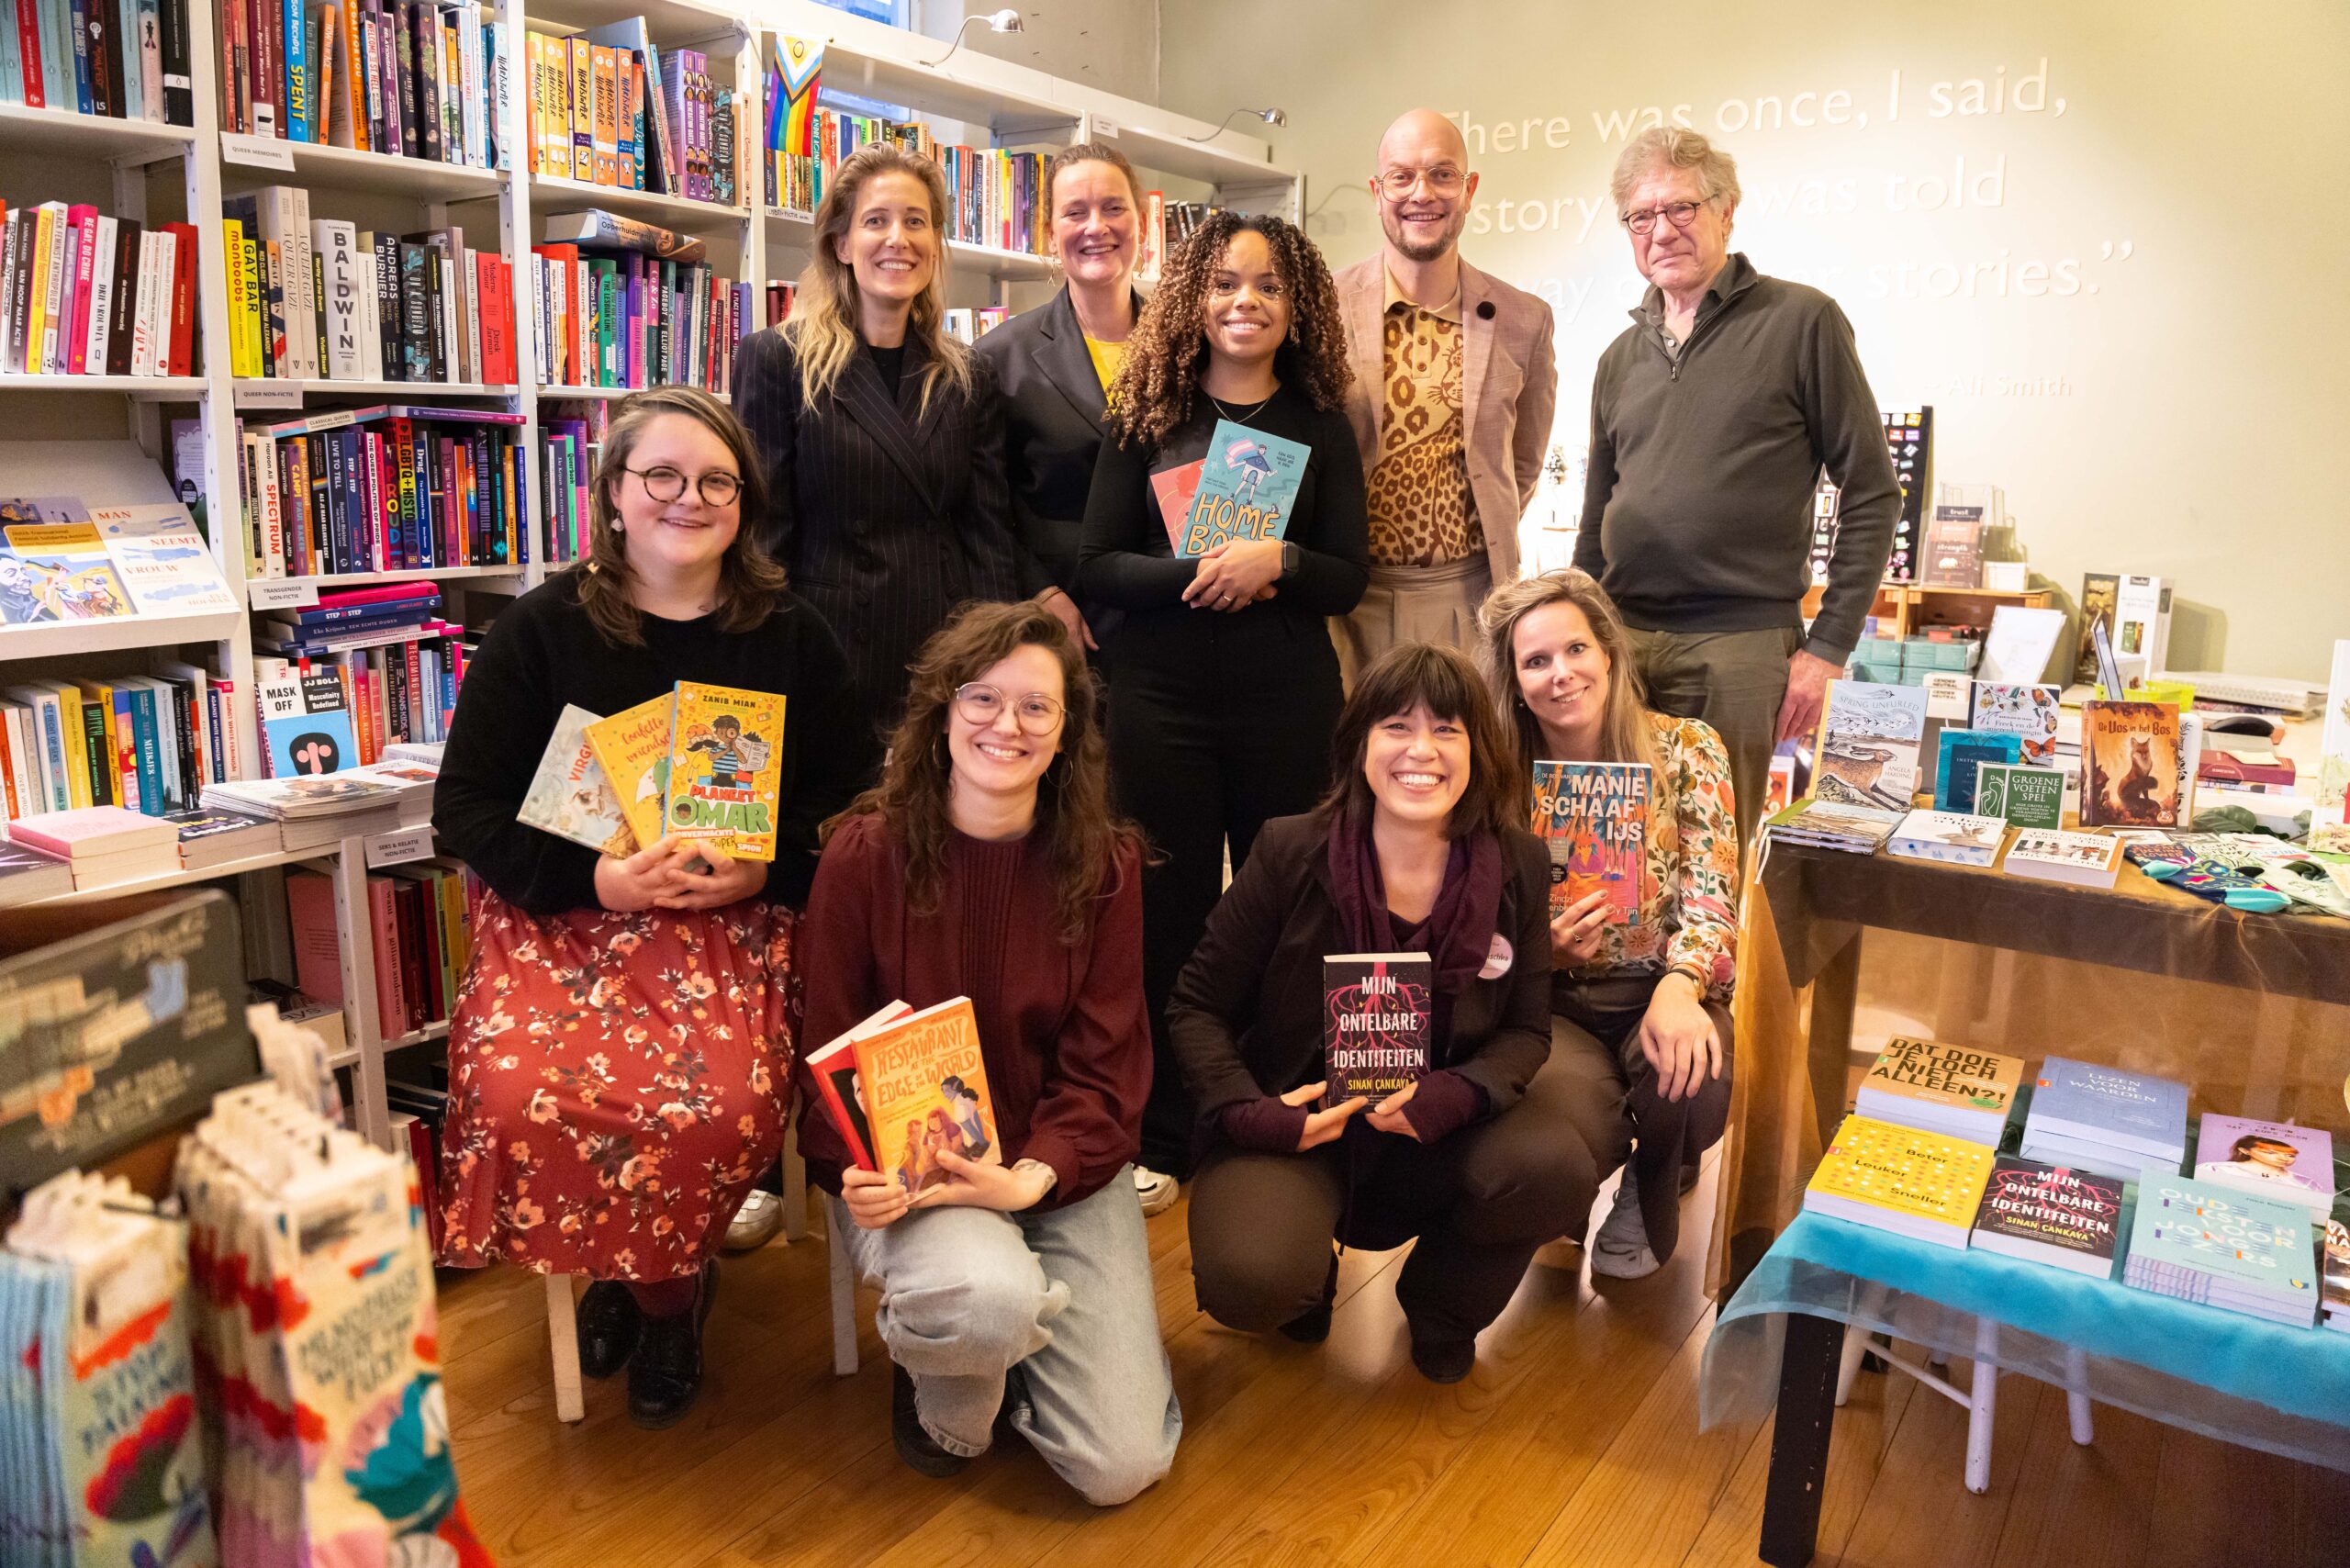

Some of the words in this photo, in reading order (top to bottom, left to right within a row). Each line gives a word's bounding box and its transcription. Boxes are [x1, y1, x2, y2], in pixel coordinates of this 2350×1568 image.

[498, 54, 509, 108] HEARTSTOPPER
[548, 65, 556, 117] HEARTSTOPPER
[291, 64, 306, 122] SPENT
[578, 67, 588, 120] HEARTSTOPPER
[596, 75, 604, 126] HEARTSTOPPER
[606, 77, 615, 128] HEARTSTOPPER
[621, 76, 630, 128] HEARTSTOPPER
[1715, 87, 1870, 135] once,
[1887, 68, 1902, 123] I
[1928, 56, 2068, 118] said,
[232, 146, 252, 155] QUEER
[252, 148, 283, 159] MEMOIRES
[1472, 194, 1606, 246] story
[1754, 174, 1859, 218] was
[1885, 153, 2008, 212] told
[56, 208, 64, 229] BLACK
[84, 217, 95, 228] BE
[39, 216, 51, 258] Financieel
[53, 230, 63, 261] FEMINIST
[83, 228, 94, 245] GAY,
[21, 242, 29, 262] MARIN
[82, 245, 92, 256] DO
[243, 244, 256, 277] GAY
[80, 257, 91, 282] CRIME
[230, 230, 243, 303] manboobs
[375, 245, 387, 299] BURNIER
[386, 237, 398, 299] ANDREAS
[707, 269, 712, 278] De
[35, 260, 48, 308] feminisme
[49, 262, 62, 310] ANTHROPOLOGY
[334, 232, 354, 350] BALDWIN
[17, 285, 26, 305] HOOP
[246, 280, 259, 313] BAR
[16, 306, 24, 326] NAAR
[14, 327, 22, 347] ACTIE
[1948, 375, 1984, 398] Ali
[1998, 375, 2073, 398] Smith
[308, 416, 333, 426] CLASSICAL
[333, 414, 351, 422] QUEERS
[97, 510, 132, 521] MAN
[266, 484, 281, 554] SPECTRUM
[1194, 491, 1281, 542] HOME
[1950, 508, 1970, 516] trust
[151, 536, 198, 546] NEEMT
[1936, 543, 1968, 554] strength
[125, 564, 179, 575] VROUW
[263, 585, 302, 595] TRANSGENDER
[268, 593, 299, 601] NON-FICTIE
[408, 644, 420, 690] BECOMING
[315, 676, 340, 686] BOLA
[266, 686, 297, 700] MASK
[308, 690, 341, 700] Masculinity
[360, 684, 368, 722] RADICAL
[412, 690, 420, 706] EVE
[702, 694, 730, 705] ZANIB
[733, 700, 756, 708] MIAN
[1839, 695, 1870, 710] SPRING
[1872, 697, 1919, 711] UNFURLED
[274, 699, 294, 711] OFF
[312, 700, 340, 711] Redefined
[621, 717, 665, 745] Confetti
[1995, 720, 2016, 729] Freek
[2028, 721, 2036, 729] de
[2098, 722, 2108, 733] De
[2108, 720, 2128, 734] Vos
[2129, 724, 2136, 733] in
[2138, 722, 2151, 734] het
[2152, 722, 2172, 735] Bos
[363, 722, 373, 763] RELATING
[1885, 771, 1912, 779] HARDING
[1887, 765, 1911, 773] ANGELA
[125, 769, 138, 798] TITS
[1572, 775, 1646, 797] MANIE
[2012, 775, 2060, 787] GROENE
[2013, 783, 2057, 795] VOETEN
[689, 784, 756, 804] PLANEET
[2021, 792, 2046, 802] SPEL
[670, 795, 772, 834] OMAR
[1539, 795, 1637, 819] SCHAAF
[1606, 821, 1642, 842] IJS
[385, 847, 416, 858] NON-FICTIE
[397, 839, 420, 848] RELATIE
[711, 836, 737, 850] SUPER
[737, 843, 763, 853] SPION
[1549, 893, 1573, 903] Zindzi
[1622, 906, 1638, 915] Tjin
[388, 937, 397, 970] gillian
[390, 970, 402, 1015] anderson
[1361, 976, 1396, 995] MIJN
[1339, 1013, 1418, 1032] ONTELBARE
[876, 1018, 964, 1079] RESTAURANT
[1334, 1048, 1424, 1069] IDENTITEITEN
[1890, 1038, 1940, 1056] DAT
[1947, 1049, 2001, 1069] DOE
[912, 1062, 920, 1072] AT
[922, 1056, 935, 1067] THE
[1886, 1048, 1919, 1063] JE
[1929, 1057, 1998, 1081] TOCH
[1897, 1060, 1960, 1081] NIET
[877, 1077, 916, 1107] EDGE
[925, 1051, 977, 1084] WORLD
[1348, 1079, 1372, 1091] SINAN
[1375, 1078, 1410, 1092] ÇANKAYA
[1871, 1066, 2007, 1103] ALLEEN?!
[2088, 1072, 2141, 1087] LEZEN
[2090, 1079, 2137, 1092] VOOR
[2069, 1081, 2157, 1103] WAARDEN
[1906, 1148, 1950, 1165] Beter
[1854, 1159, 1908, 1178] Leuker
[2037, 1170, 2080, 1189] MIJN
[1889, 1187, 1947, 1207] Sneller
[2005, 1182, 2105, 1214] ONTELBARE
[1991, 1198, 2109, 1234] IDENTITEITEN
[2006, 1216, 2038, 1229] SINAN
[2042, 1225, 2089, 1241] ÇANKAYA
